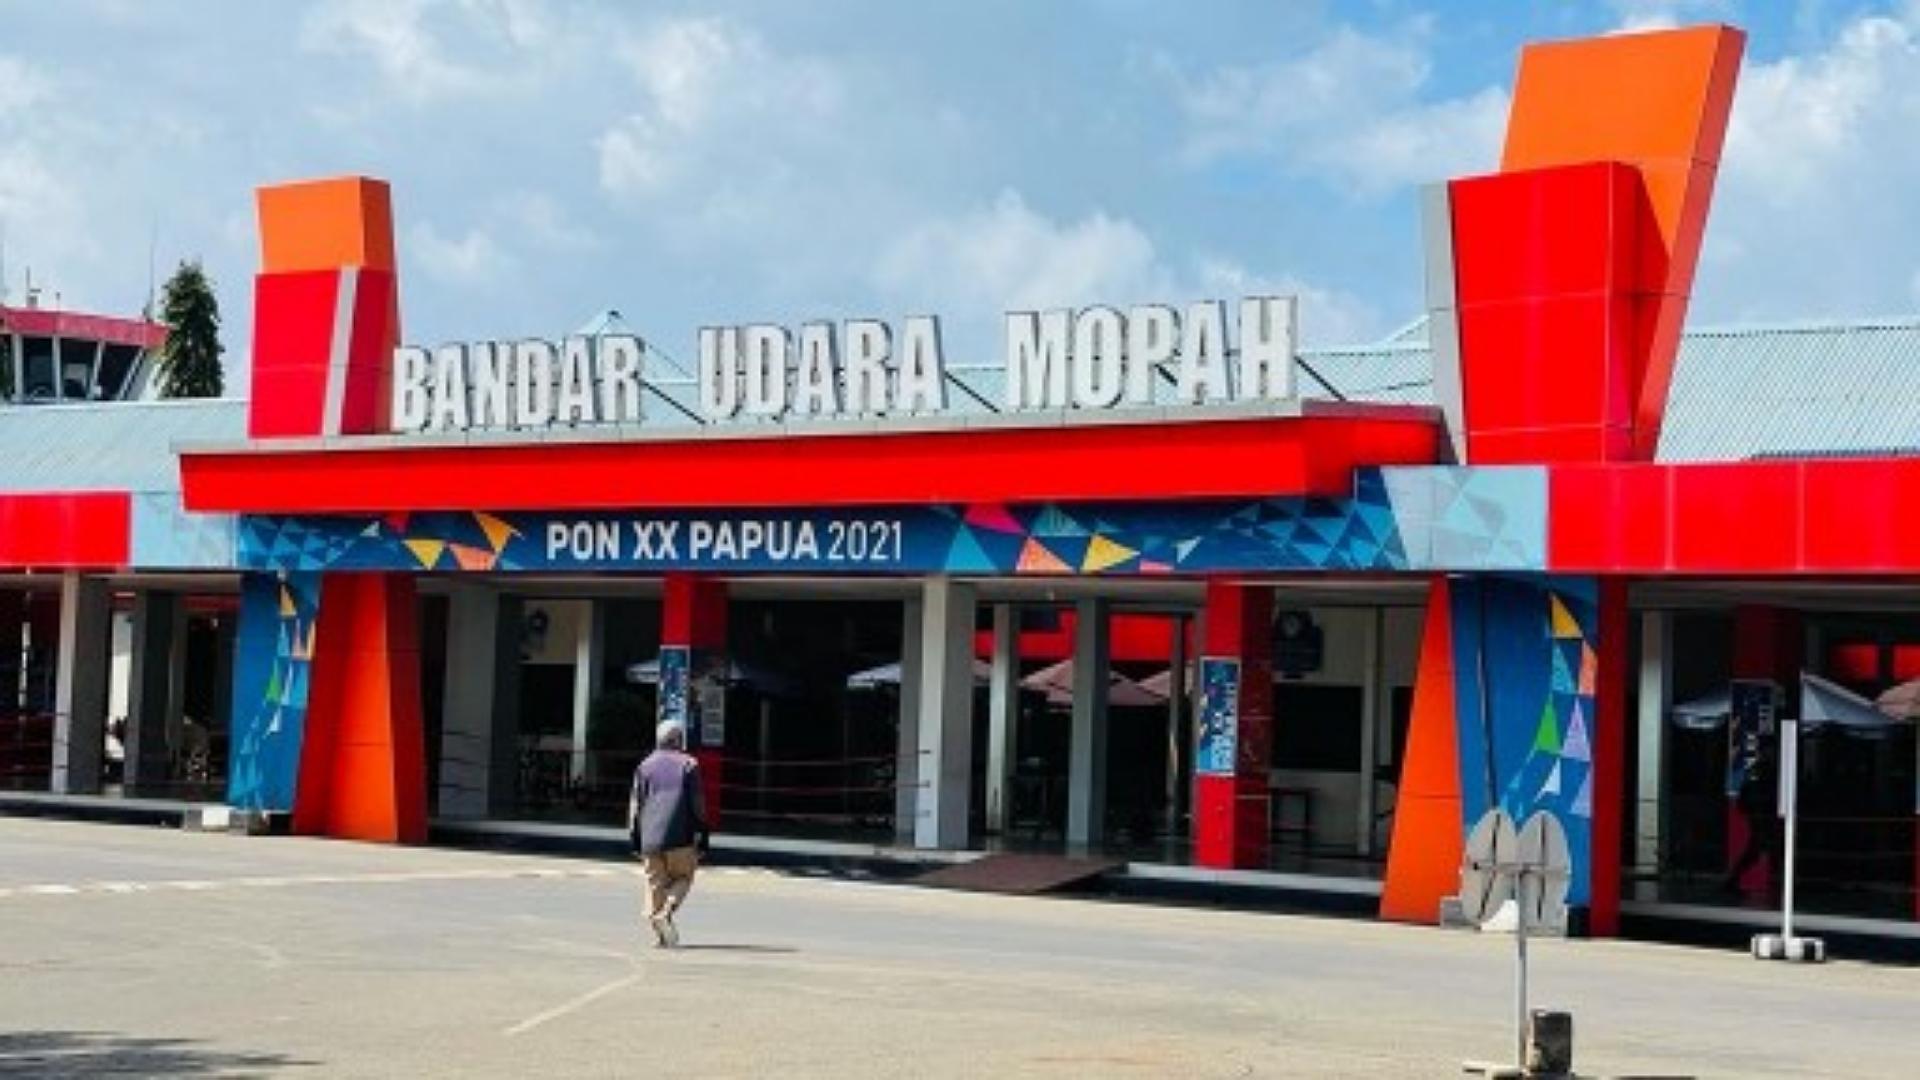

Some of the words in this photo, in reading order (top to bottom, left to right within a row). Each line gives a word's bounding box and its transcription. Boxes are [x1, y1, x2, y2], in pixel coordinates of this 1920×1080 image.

[391, 335, 644, 431] BANDAR
[699, 315, 949, 418] UDARA
[1005, 296, 1297, 407] MOPAH
[547, 521, 619, 560] PON
[632, 521, 679, 560] XX
[689, 521, 819, 560] PAPUA
[827, 521, 901, 560] 2021
